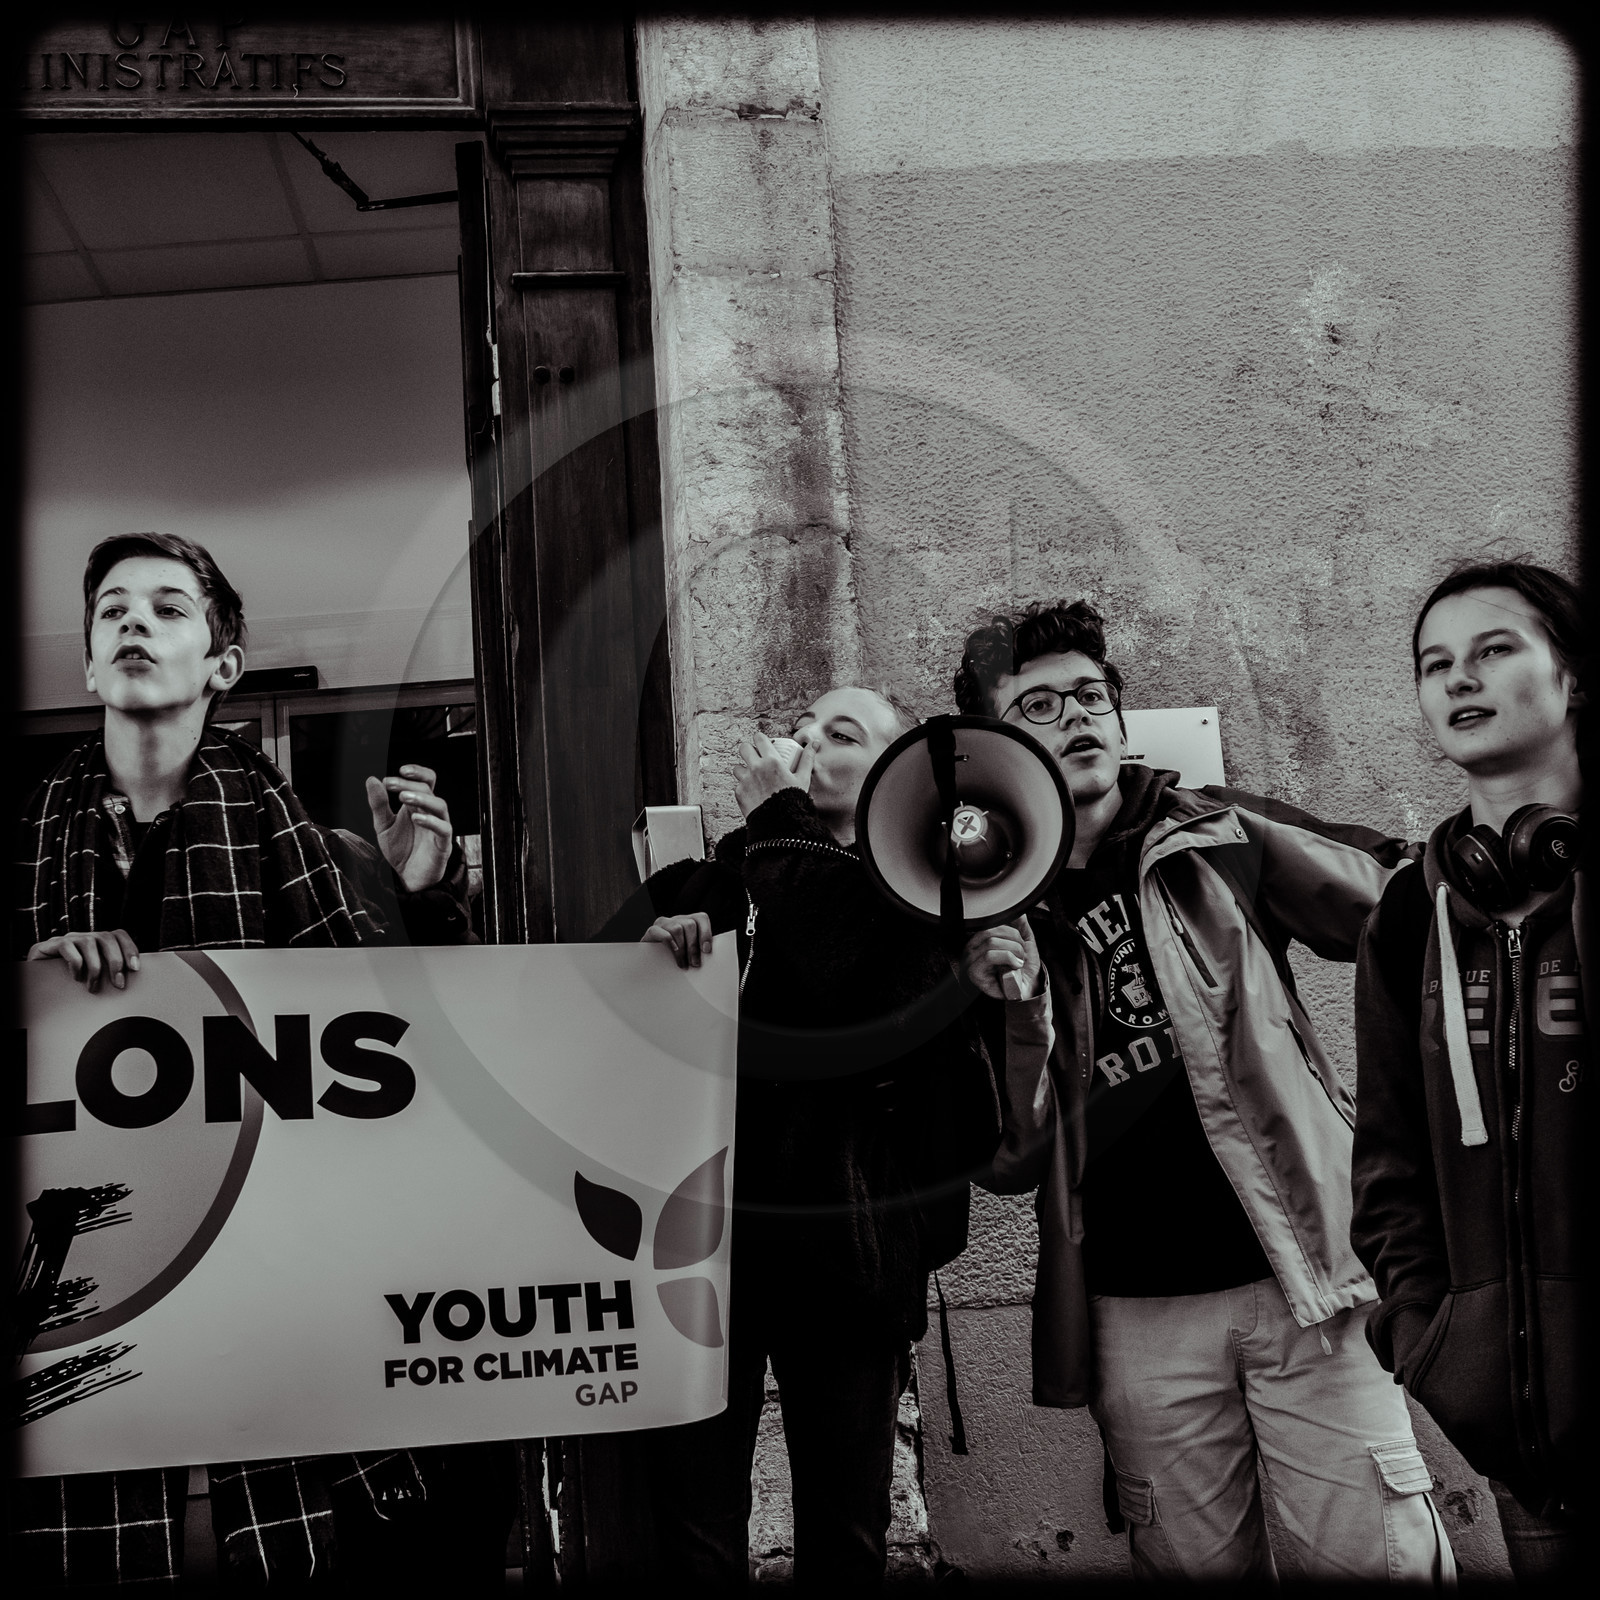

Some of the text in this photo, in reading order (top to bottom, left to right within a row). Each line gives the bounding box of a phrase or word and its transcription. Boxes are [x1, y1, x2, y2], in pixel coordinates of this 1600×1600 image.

[16, 1011, 416, 1138] LONS
[383, 1279, 635, 1345] YOUTH
[384, 1343, 639, 1388] FOR CLIMATE
[575, 1380, 639, 1407] GAP
